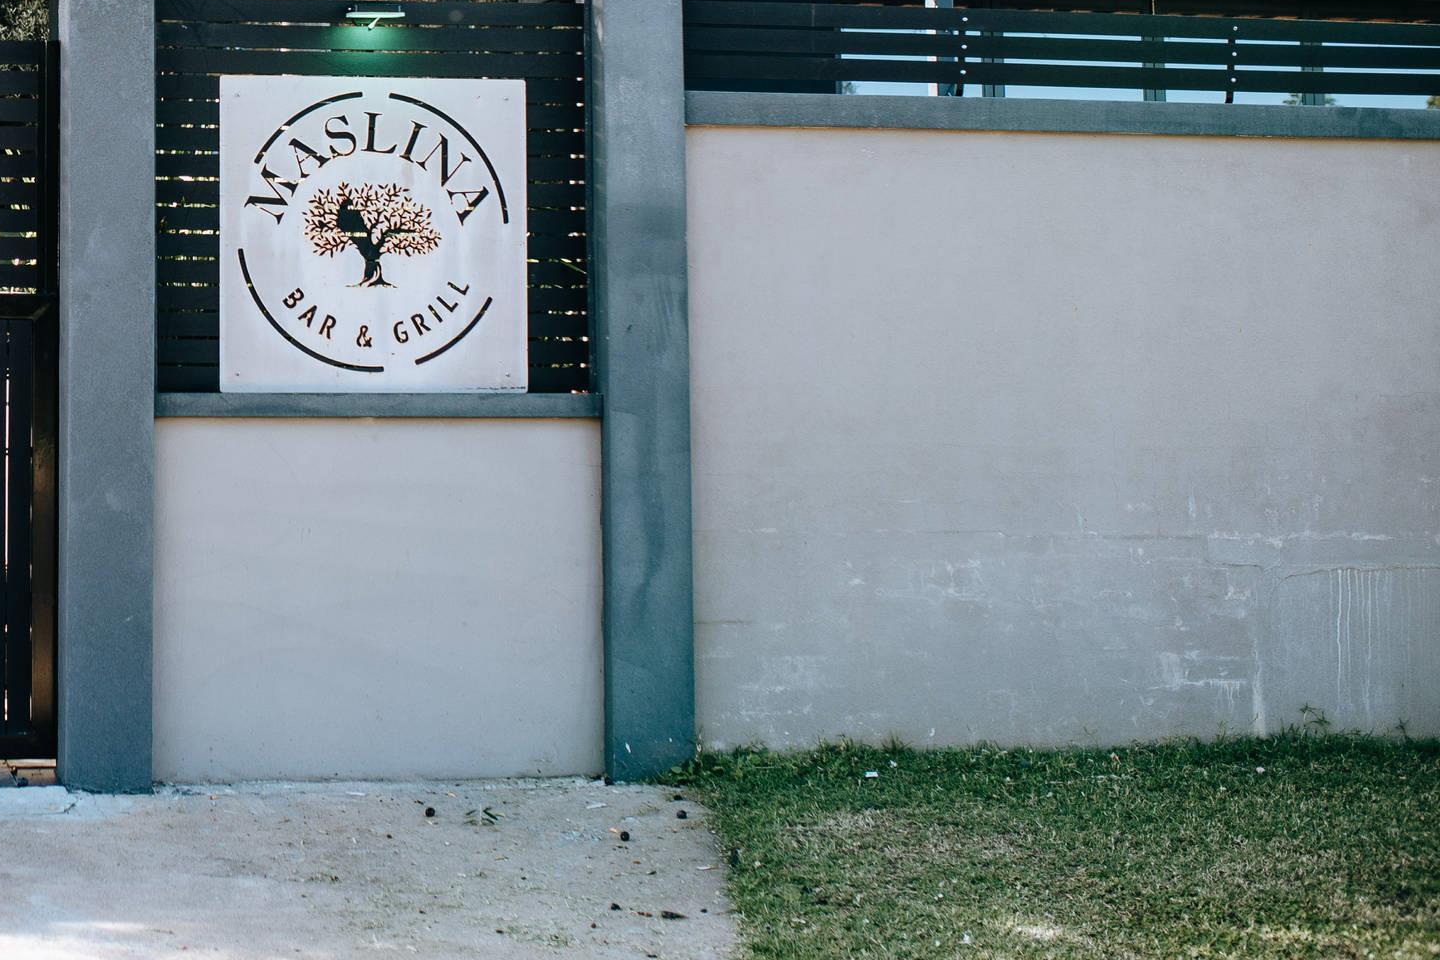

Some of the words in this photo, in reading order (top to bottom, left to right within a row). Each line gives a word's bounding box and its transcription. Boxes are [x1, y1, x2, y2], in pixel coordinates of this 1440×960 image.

[244, 111, 490, 226] MASLINA
[282, 288, 337, 340] BAR
[356, 325, 372, 348] &
[393, 281, 470, 344] GRILL
